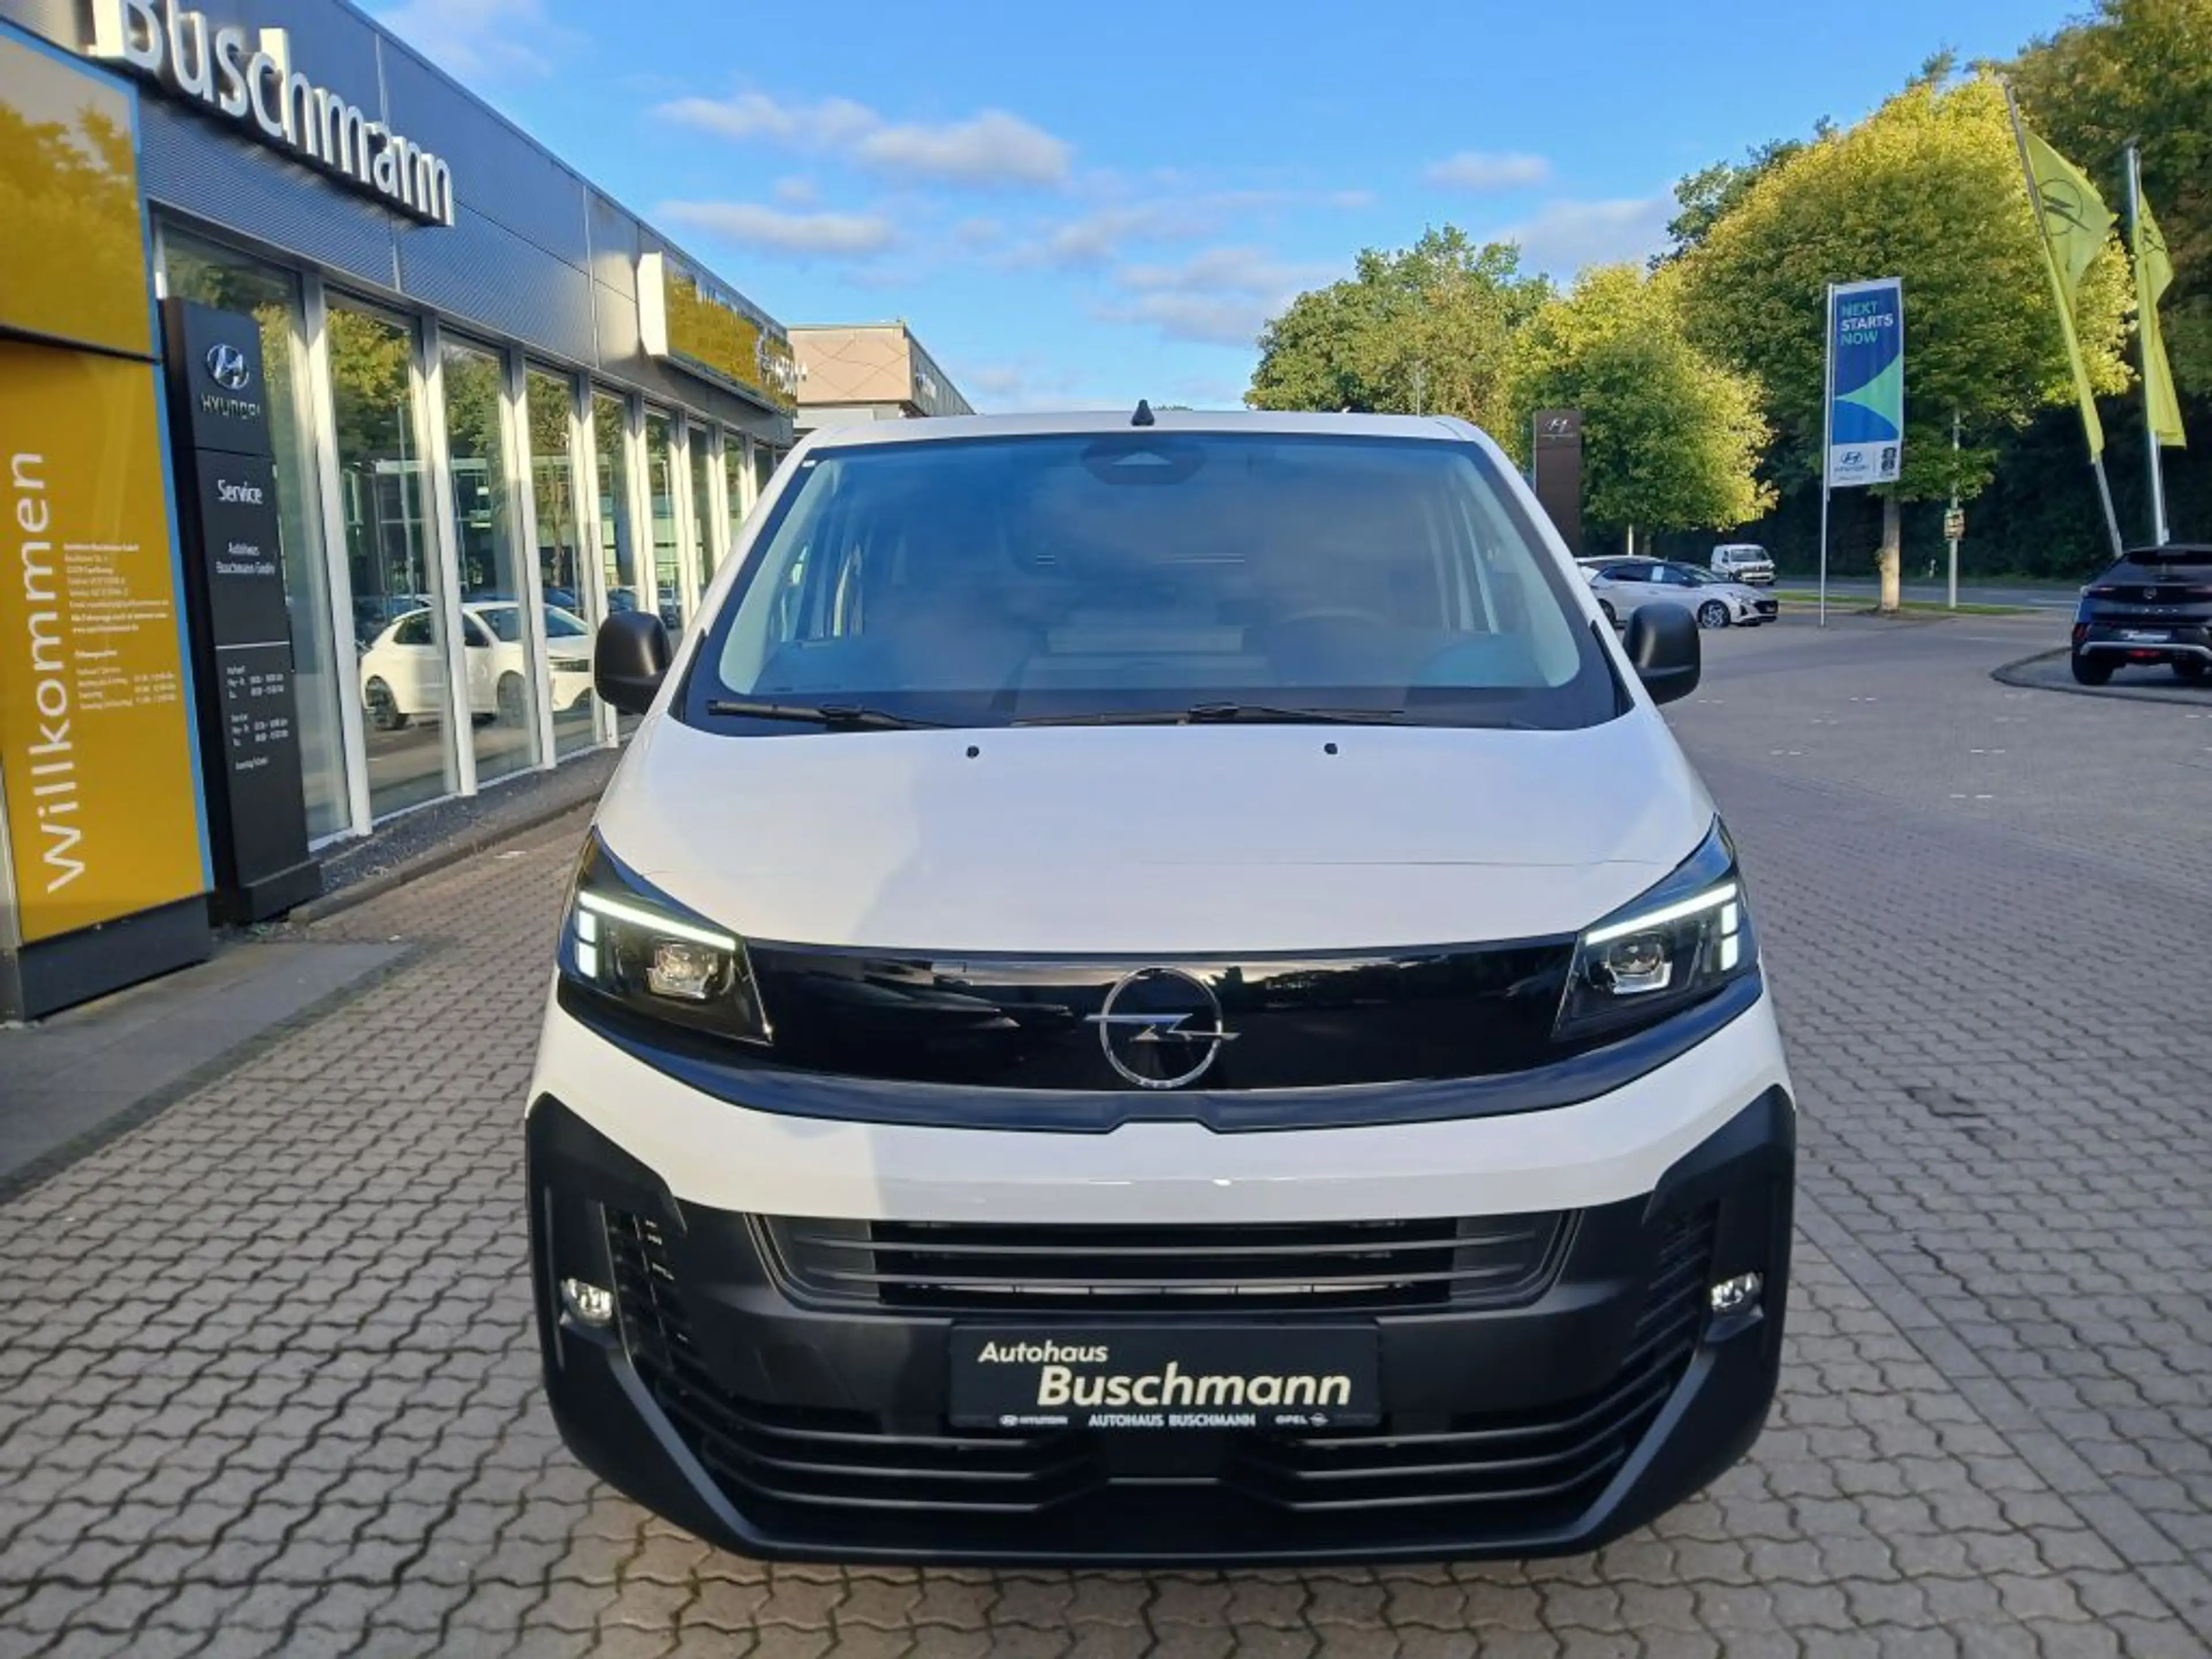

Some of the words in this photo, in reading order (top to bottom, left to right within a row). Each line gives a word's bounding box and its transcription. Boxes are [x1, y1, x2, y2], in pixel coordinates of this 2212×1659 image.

[1840, 300, 1878, 317] NEXT
[1841, 313, 1893, 332] STARTS
[1840, 329, 1878, 346] NOW
[218, 479, 263, 505] Service
[12, 452, 85, 893] Willkommen
[978, 1340, 1108, 1363] Autohaus
[1037, 1361, 1351, 1406] Buschmann
[1088, 1414, 1164, 1427] AUTOHAUS
[1168, 1414, 1256, 1427] BUSCHMANN
[1275, 1415, 1308, 1425] OPEL
